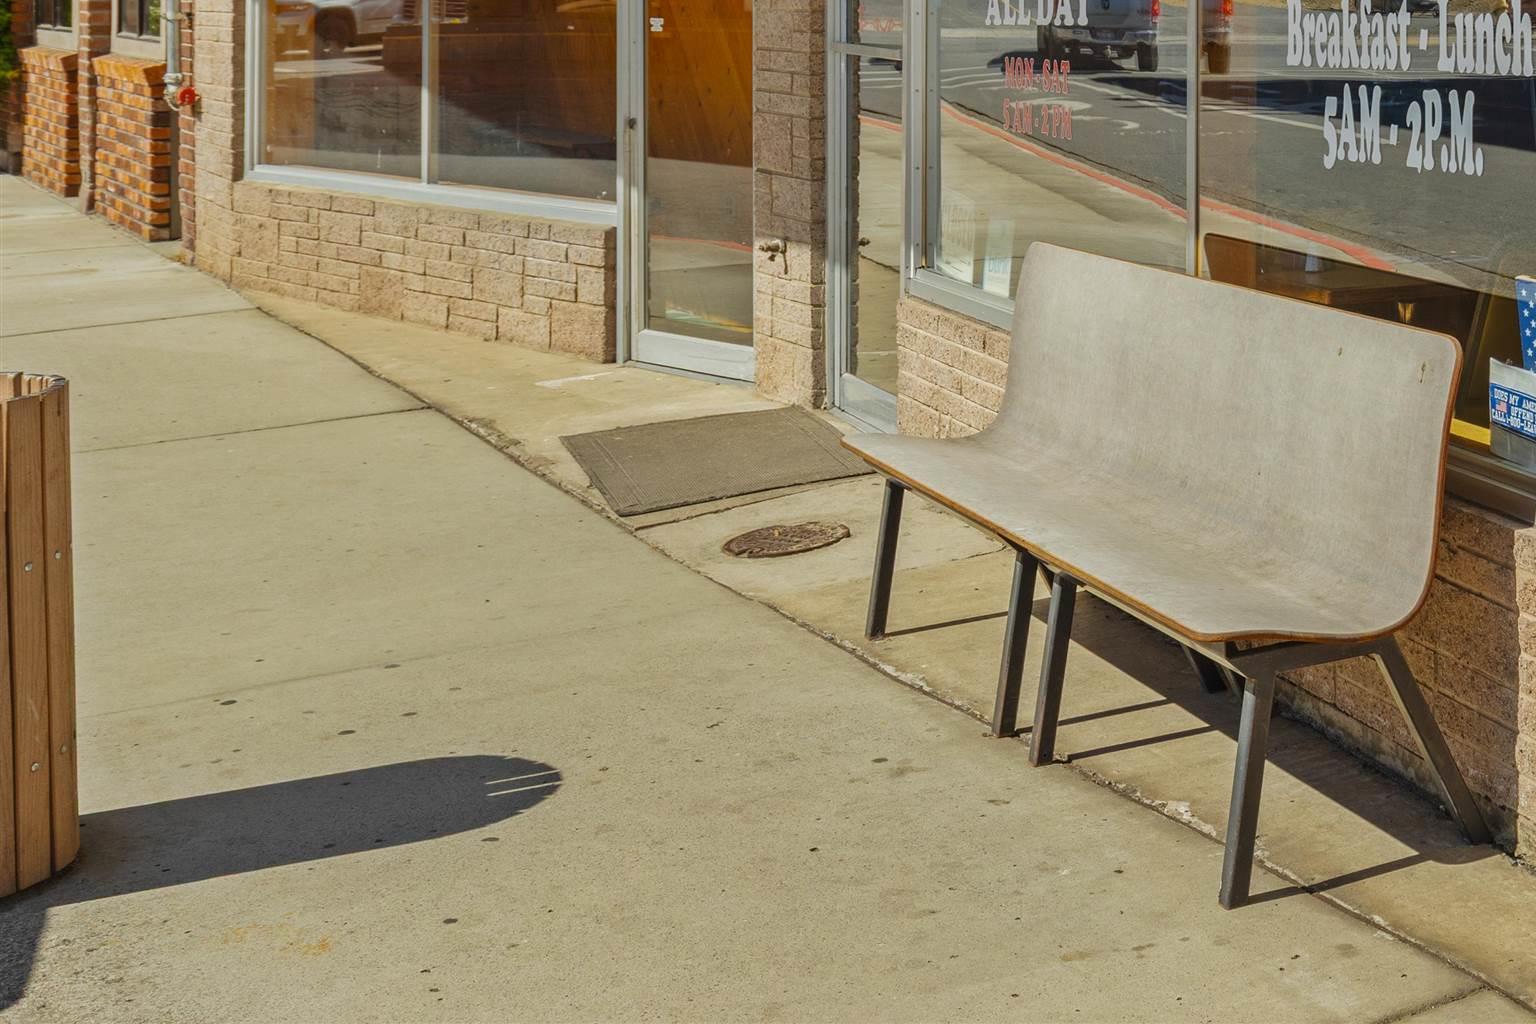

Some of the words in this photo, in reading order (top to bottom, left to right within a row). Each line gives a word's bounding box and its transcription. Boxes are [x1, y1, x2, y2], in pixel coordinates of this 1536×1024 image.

[1004, 56, 1034, 89] MON
[1042, 58, 1071, 94] SAT
[1322, 82, 1381, 170] 5AM
[1406, 88, 1484, 177] 2P.M.
[1493, 387, 1509, 403] DOES
[1509, 392, 1520, 406] MY
[1491, 407, 1506, 423] CALL
[1511, 406, 1534, 423] OFFEND
